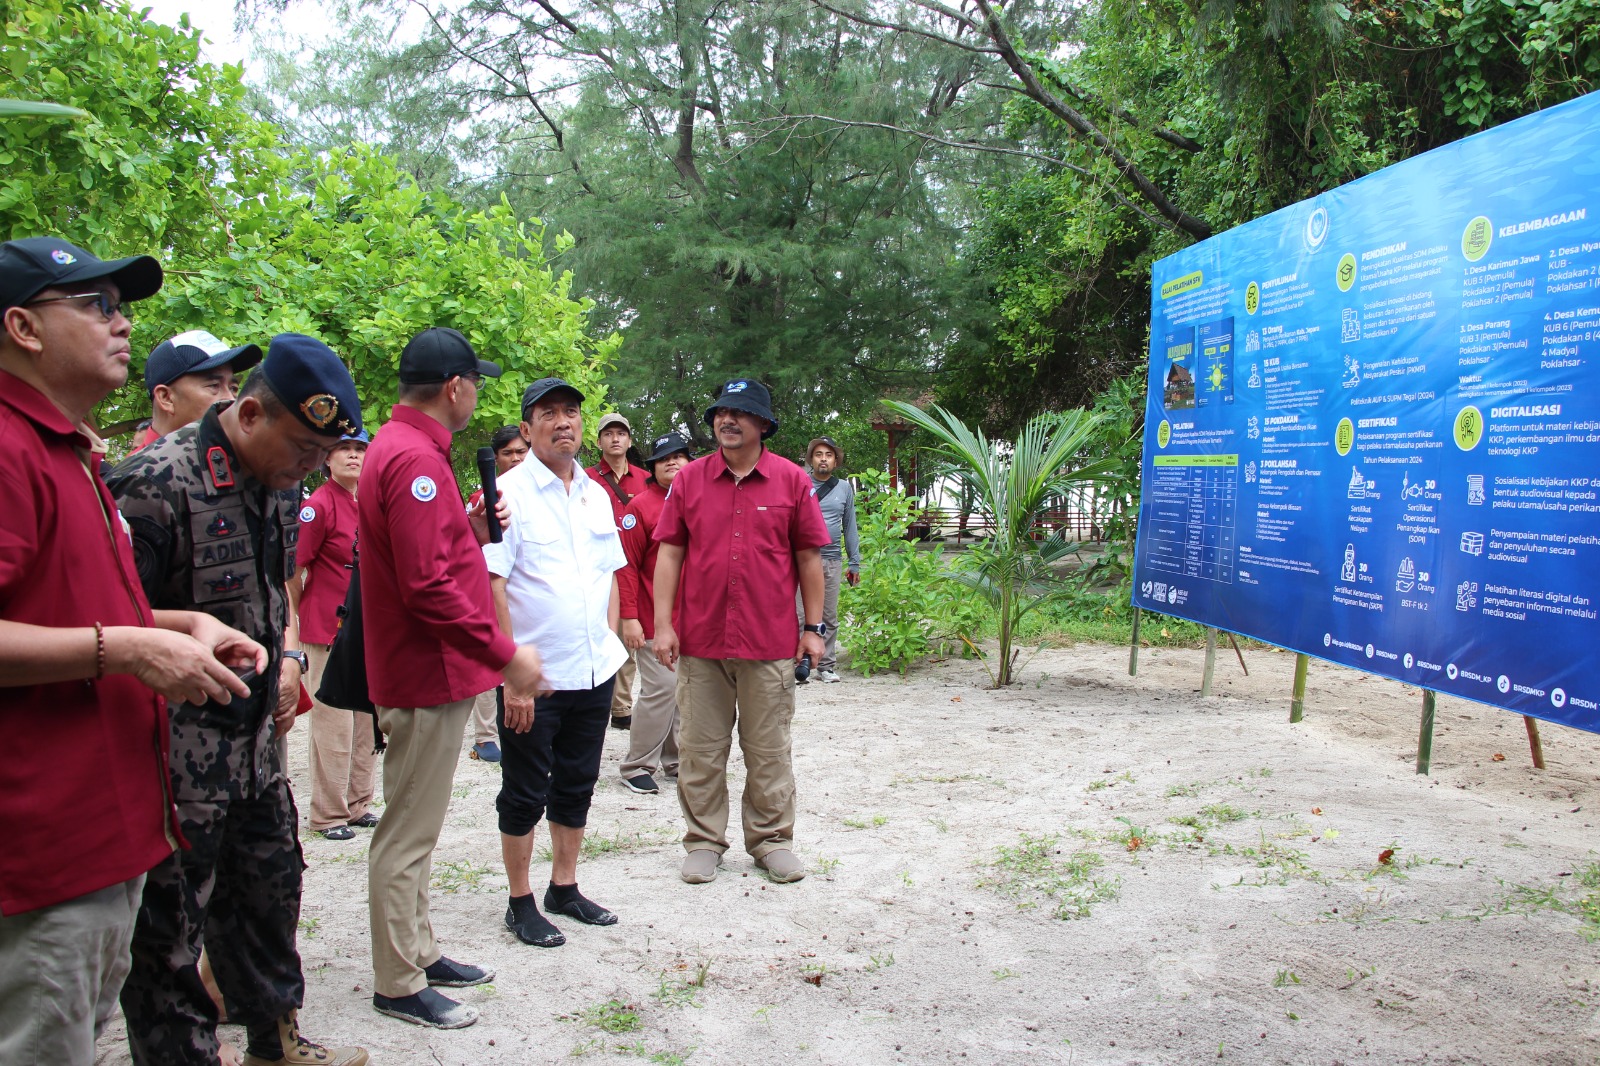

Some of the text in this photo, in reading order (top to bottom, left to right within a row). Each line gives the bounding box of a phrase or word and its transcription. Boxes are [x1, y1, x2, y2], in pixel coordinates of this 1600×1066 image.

[1499, 208, 1586, 238] KELEMBAGAAN
[1362, 242, 1406, 262] PENDIDIKAN
[1414, 250, 1427, 259] SDM
[1549, 246, 1580, 258] 2. Desa
[1422, 256, 1448, 268] program
[1470, 264, 1486, 275] Desa
[1488, 259, 1518, 272] Karimun
[1520, 254, 1540, 264] Jawa
[1548, 260, 1566, 270] KUB
[1464, 270, 1515, 286] KUB (Pemula)
[1547, 266, 1596, 282] Pokdakan 2
[1262, 272, 1297, 290] PENYULUHAN
[1462, 277, 1534, 298] Pokdakan (Pemula)
[1546, 281, 1587, 294] Poklahsar
[1422, 300, 1434, 308] oleh
[1462, 289, 1533, 308] Poklahsar (Pemula)
[1417, 311, 1436, 320] satuan
[1544, 312, 1575, 321] 4. Desa
[1467, 322, 1484, 332] Desa
[1485, 320, 1510, 330] Parang
[1544, 322, 1568, 333] KUB 6
[1460, 330, 1511, 344] KUB (Pemula)
[1542, 332, 1590, 345] Pokdakan 8
[1460, 345, 1490, 354] Pokdakan
[1549, 345, 1578, 356] Madya)
[1459, 356, 1490, 366] Poklahsar
[1541, 358, 1581, 369] Poklahsar
[1402, 393, 1416, 402] Tegal
[1491, 404, 1561, 418] DIGITALISASI
[1270, 415, 1299, 425] POKDAKAN
[1358, 417, 1397, 428] SERTIFIKASI
[1490, 422, 1572, 432] Platform untuk materi
[1385, 432, 1406, 440] program
[1407, 430, 1434, 439] sertifikasi
[1506, 434, 1564, 445] perkembangan
[1565, 434, 1584, 443] ilmu
[1488, 447, 1538, 457] teknologi KKP
[1264, 460, 1297, 468] POKLAHSAR
[1366, 481, 1375, 489] 30
[1425, 480, 1435, 489] 30
[1494, 476, 1589, 487] Sosialisasi kebijakan KKP
[1366, 491, 1380, 499] Orang
[1425, 492, 1442, 500] Orang
[1494, 488, 1596, 500] bentuk audiovisual kepada
[1407, 504, 1433, 512] Sertifikat
[1492, 500, 1516, 509] pelaku
[1403, 514, 1436, 523] Operasional
[1397, 524, 1427, 534] Penangkap
[1490, 528, 1566, 543] Penyampaian materi
[202, 539, 247, 564] ADIN
[1489, 541, 1576, 556] dan penyuluhan secara
[1488, 553, 1528, 563] audiovisual
[1359, 563, 1368, 572] 30
[1359, 574, 1373, 583] Orang
[1418, 572, 1429, 582] 30
[1418, 583, 1435, 594] Orang
[1485, 584, 1589, 605] Pelatihan literasi digital dan
[1483, 596, 1597, 619] penyebaran informasi melalui
[1482, 608, 1526, 620] media sosial
[1417, 660, 1442, 671] BRSDMKP
[1461, 671, 1492, 683] BRSDM_KP
[1513, 684, 1545, 697] BRSDMKP
[1570, 697, 1597, 710] BRSDM
